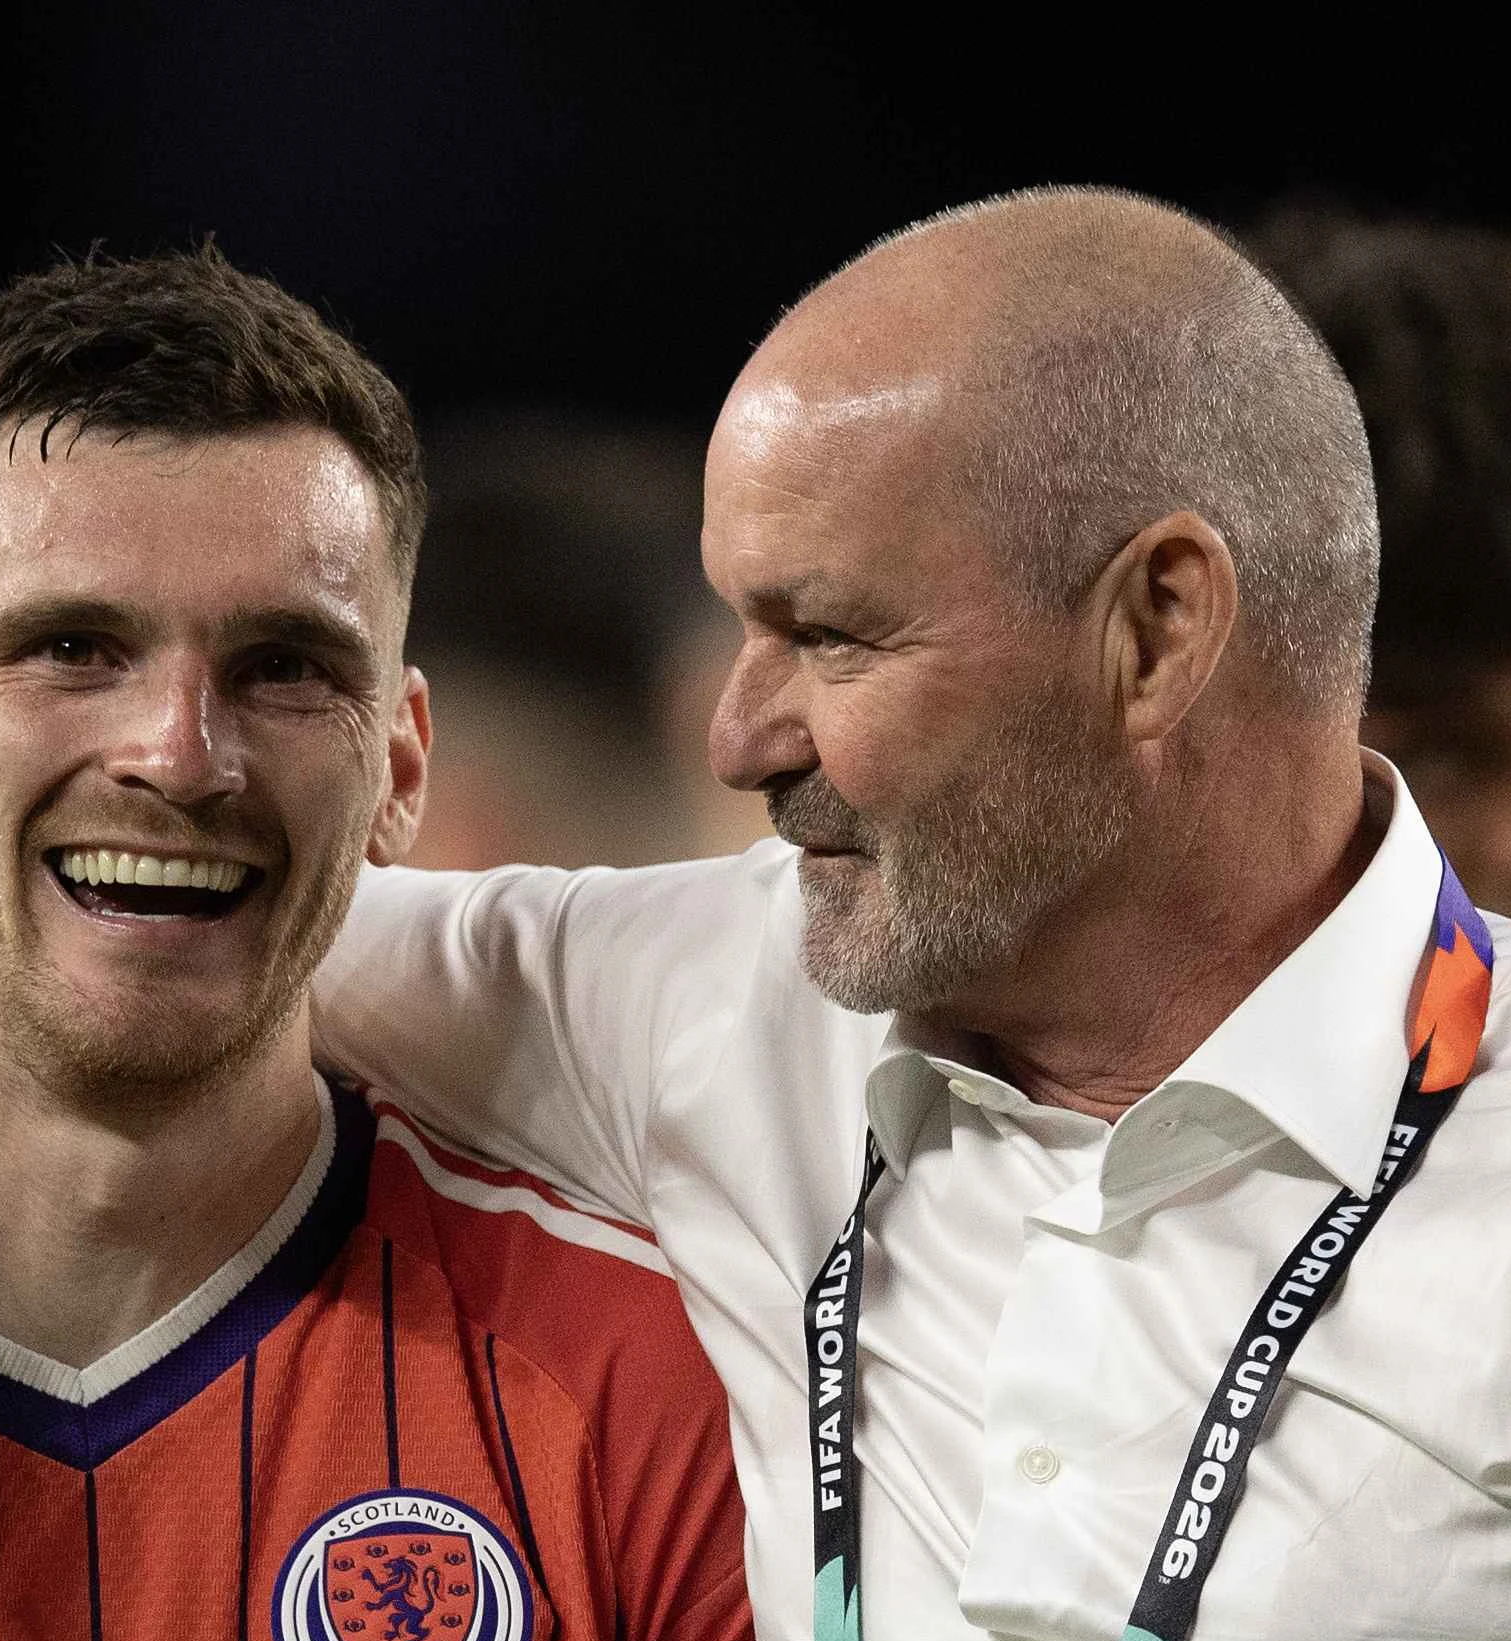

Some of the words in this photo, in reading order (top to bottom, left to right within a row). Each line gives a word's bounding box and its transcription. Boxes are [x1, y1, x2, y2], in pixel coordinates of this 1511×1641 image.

[1372, 1123, 1419, 1196] FIF
[1267, 1205, 1370, 1329] WORLD
[816, 1250, 852, 1406] WORLD
[1227, 1335, 1280, 1419] CUP
[817, 1409, 844, 1512] FIFA
[1162, 1422, 1240, 1579] 2026
[338, 1502, 455, 1534] SCOTLAND
